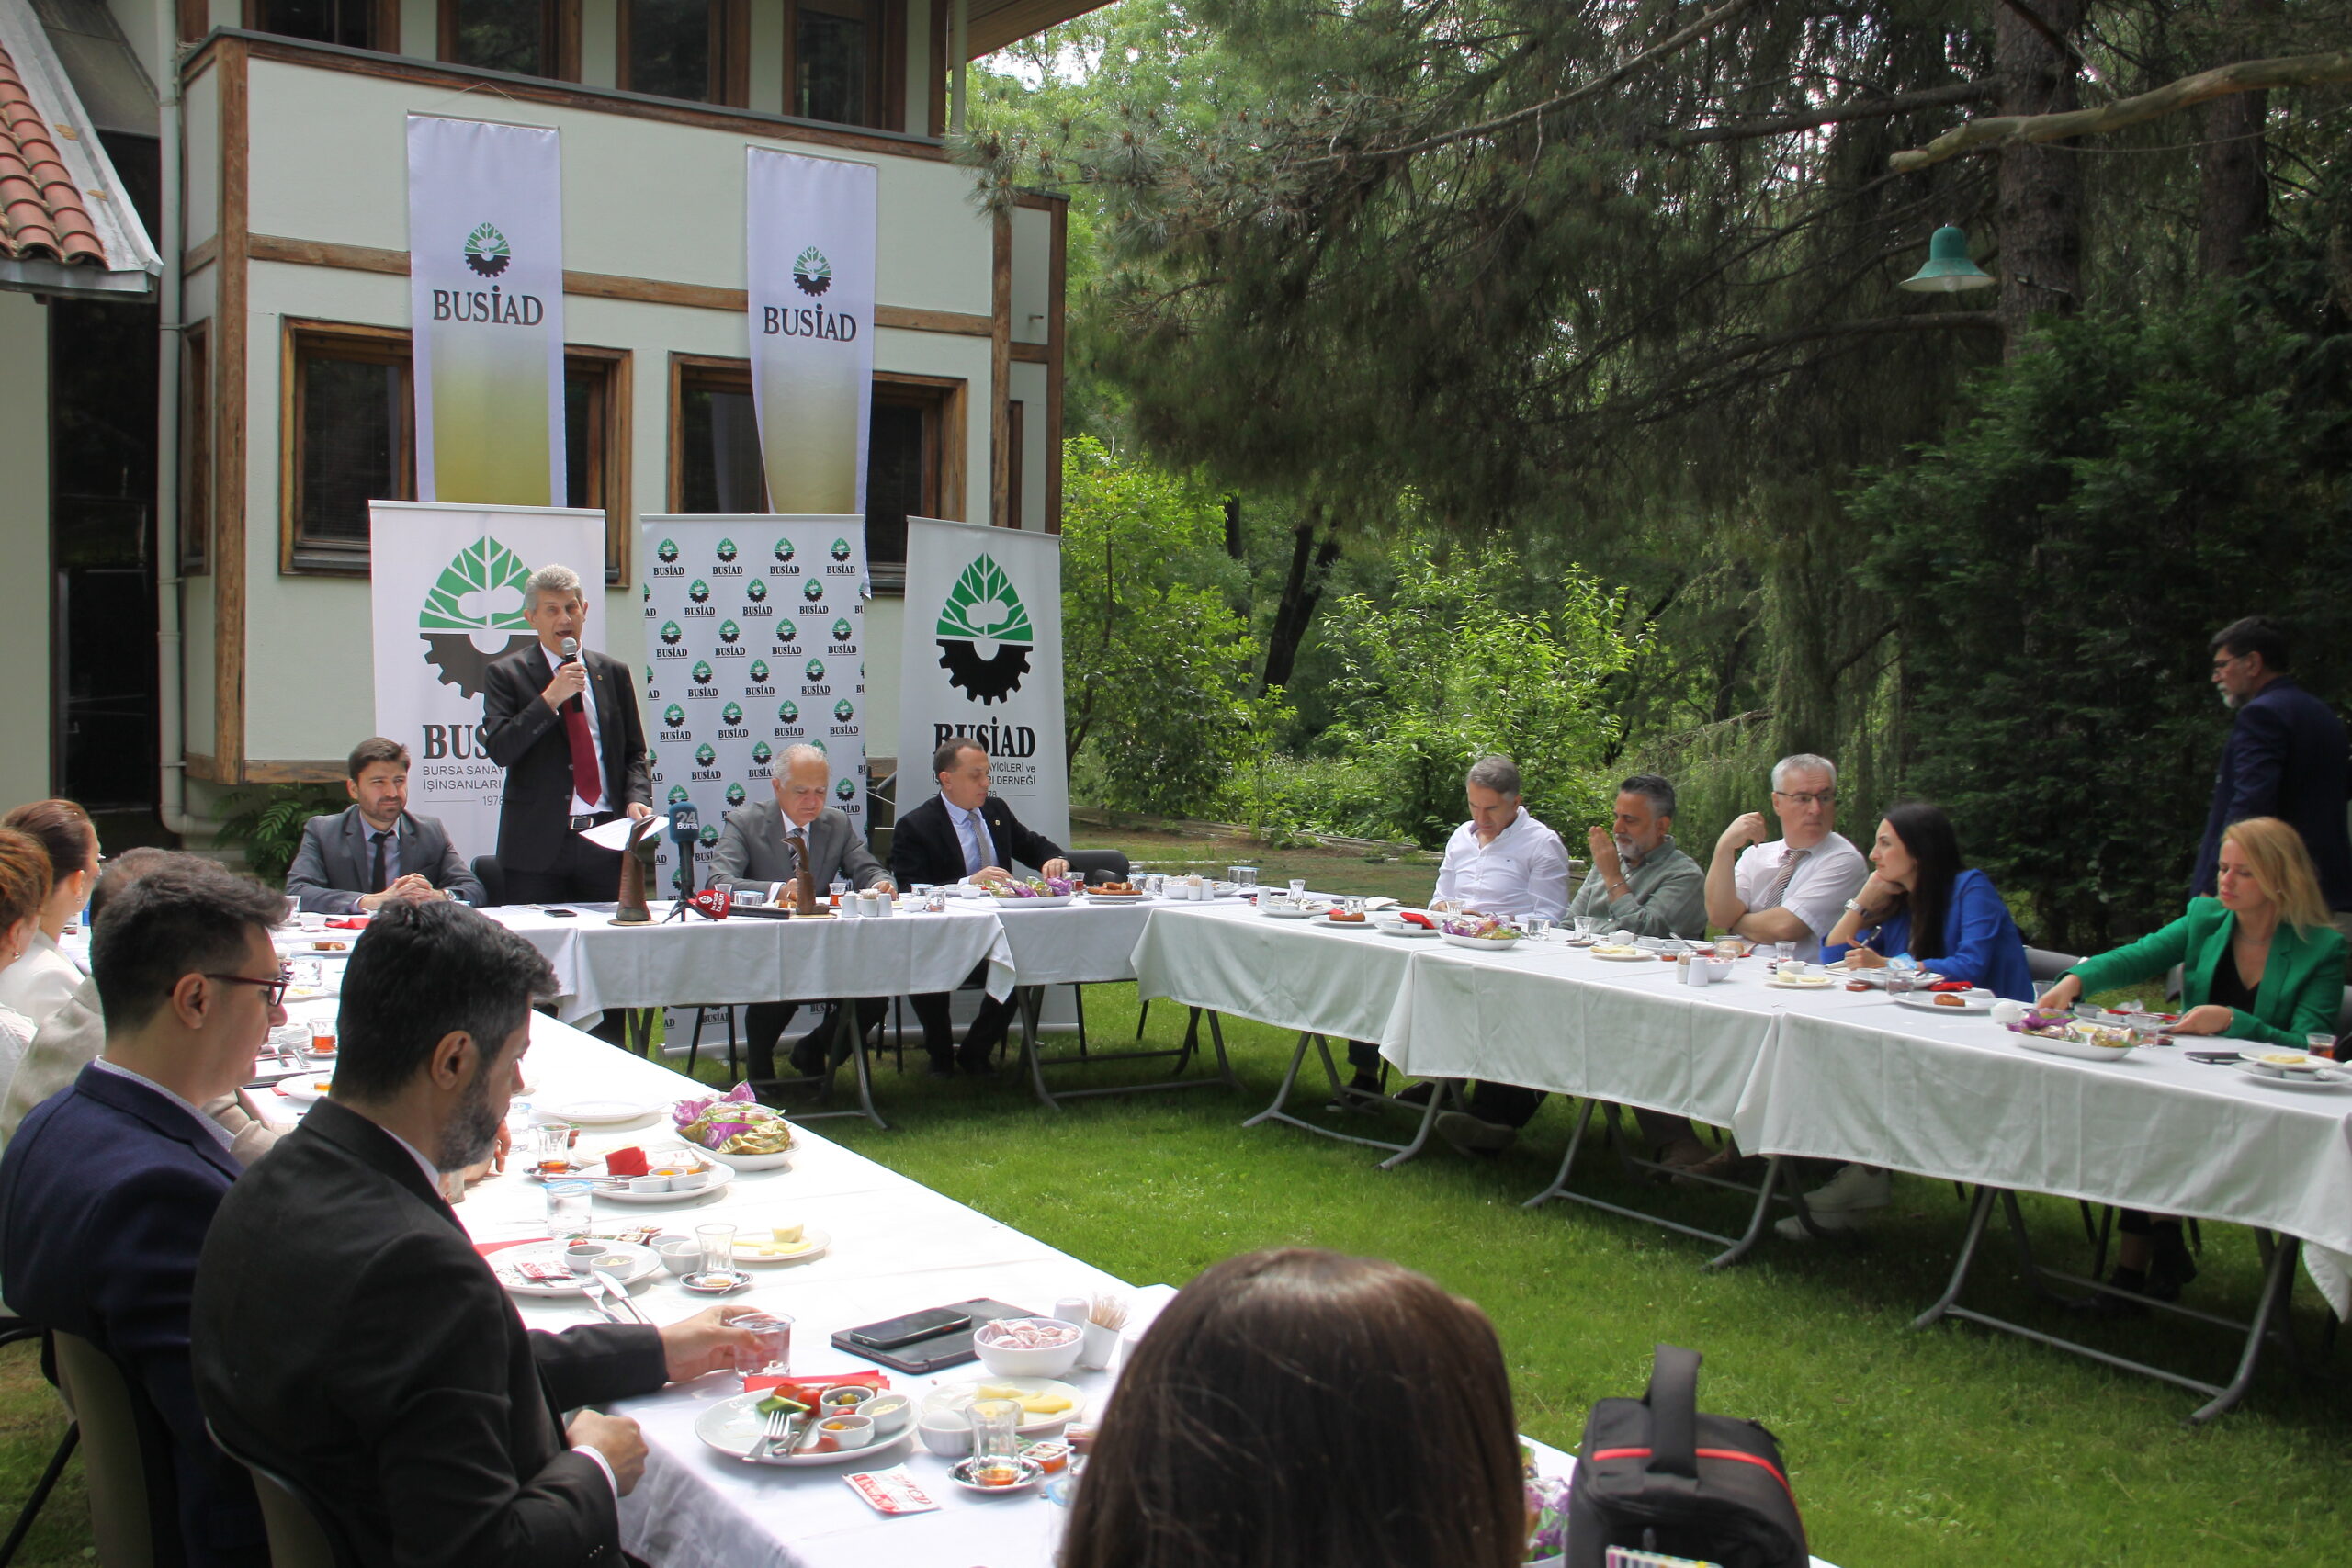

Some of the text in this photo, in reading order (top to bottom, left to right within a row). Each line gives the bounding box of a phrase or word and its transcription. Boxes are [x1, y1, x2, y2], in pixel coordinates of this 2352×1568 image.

[433, 285, 544, 326] BUSİAD
[763, 303, 857, 343] BUSİAD
[653, 565, 684, 576] BUSİAD
[712, 564, 743, 575] BUSİAD
[770, 563, 800, 575] BUSİAD
[826, 563, 855, 574] BUSİAD
[684, 605, 716, 616] BUSİAD
[742, 604, 773, 615] BUSİAD
[799, 604, 829, 615] BUSİAD
[656, 647, 688, 658] BUSİAD
[715, 645, 746, 656] BUSİAD
[772, 644, 802, 655] BUSİAD
[828, 643, 857, 654] BUSİAD
[687, 686, 718, 697] BUSİAD
[745, 685, 775, 695] BUSİAD
[801, 683, 831, 694] BUSİAD
[660, 729, 692, 740] BUSİAD
[718, 728, 749, 739] BUSİAD
[775, 726, 804, 737] BUSİAD
[830, 724, 859, 735] BUSİAD
[422, 724, 490, 760] BUS
[423, 765, 504, 776] BURSA SANAY
[691, 769, 721, 780] BUSİAD
[748, 767, 773, 778] BUSİA
[424, 778, 502, 792] İŞİNSANLARI
[675, 811, 697, 823] 24
